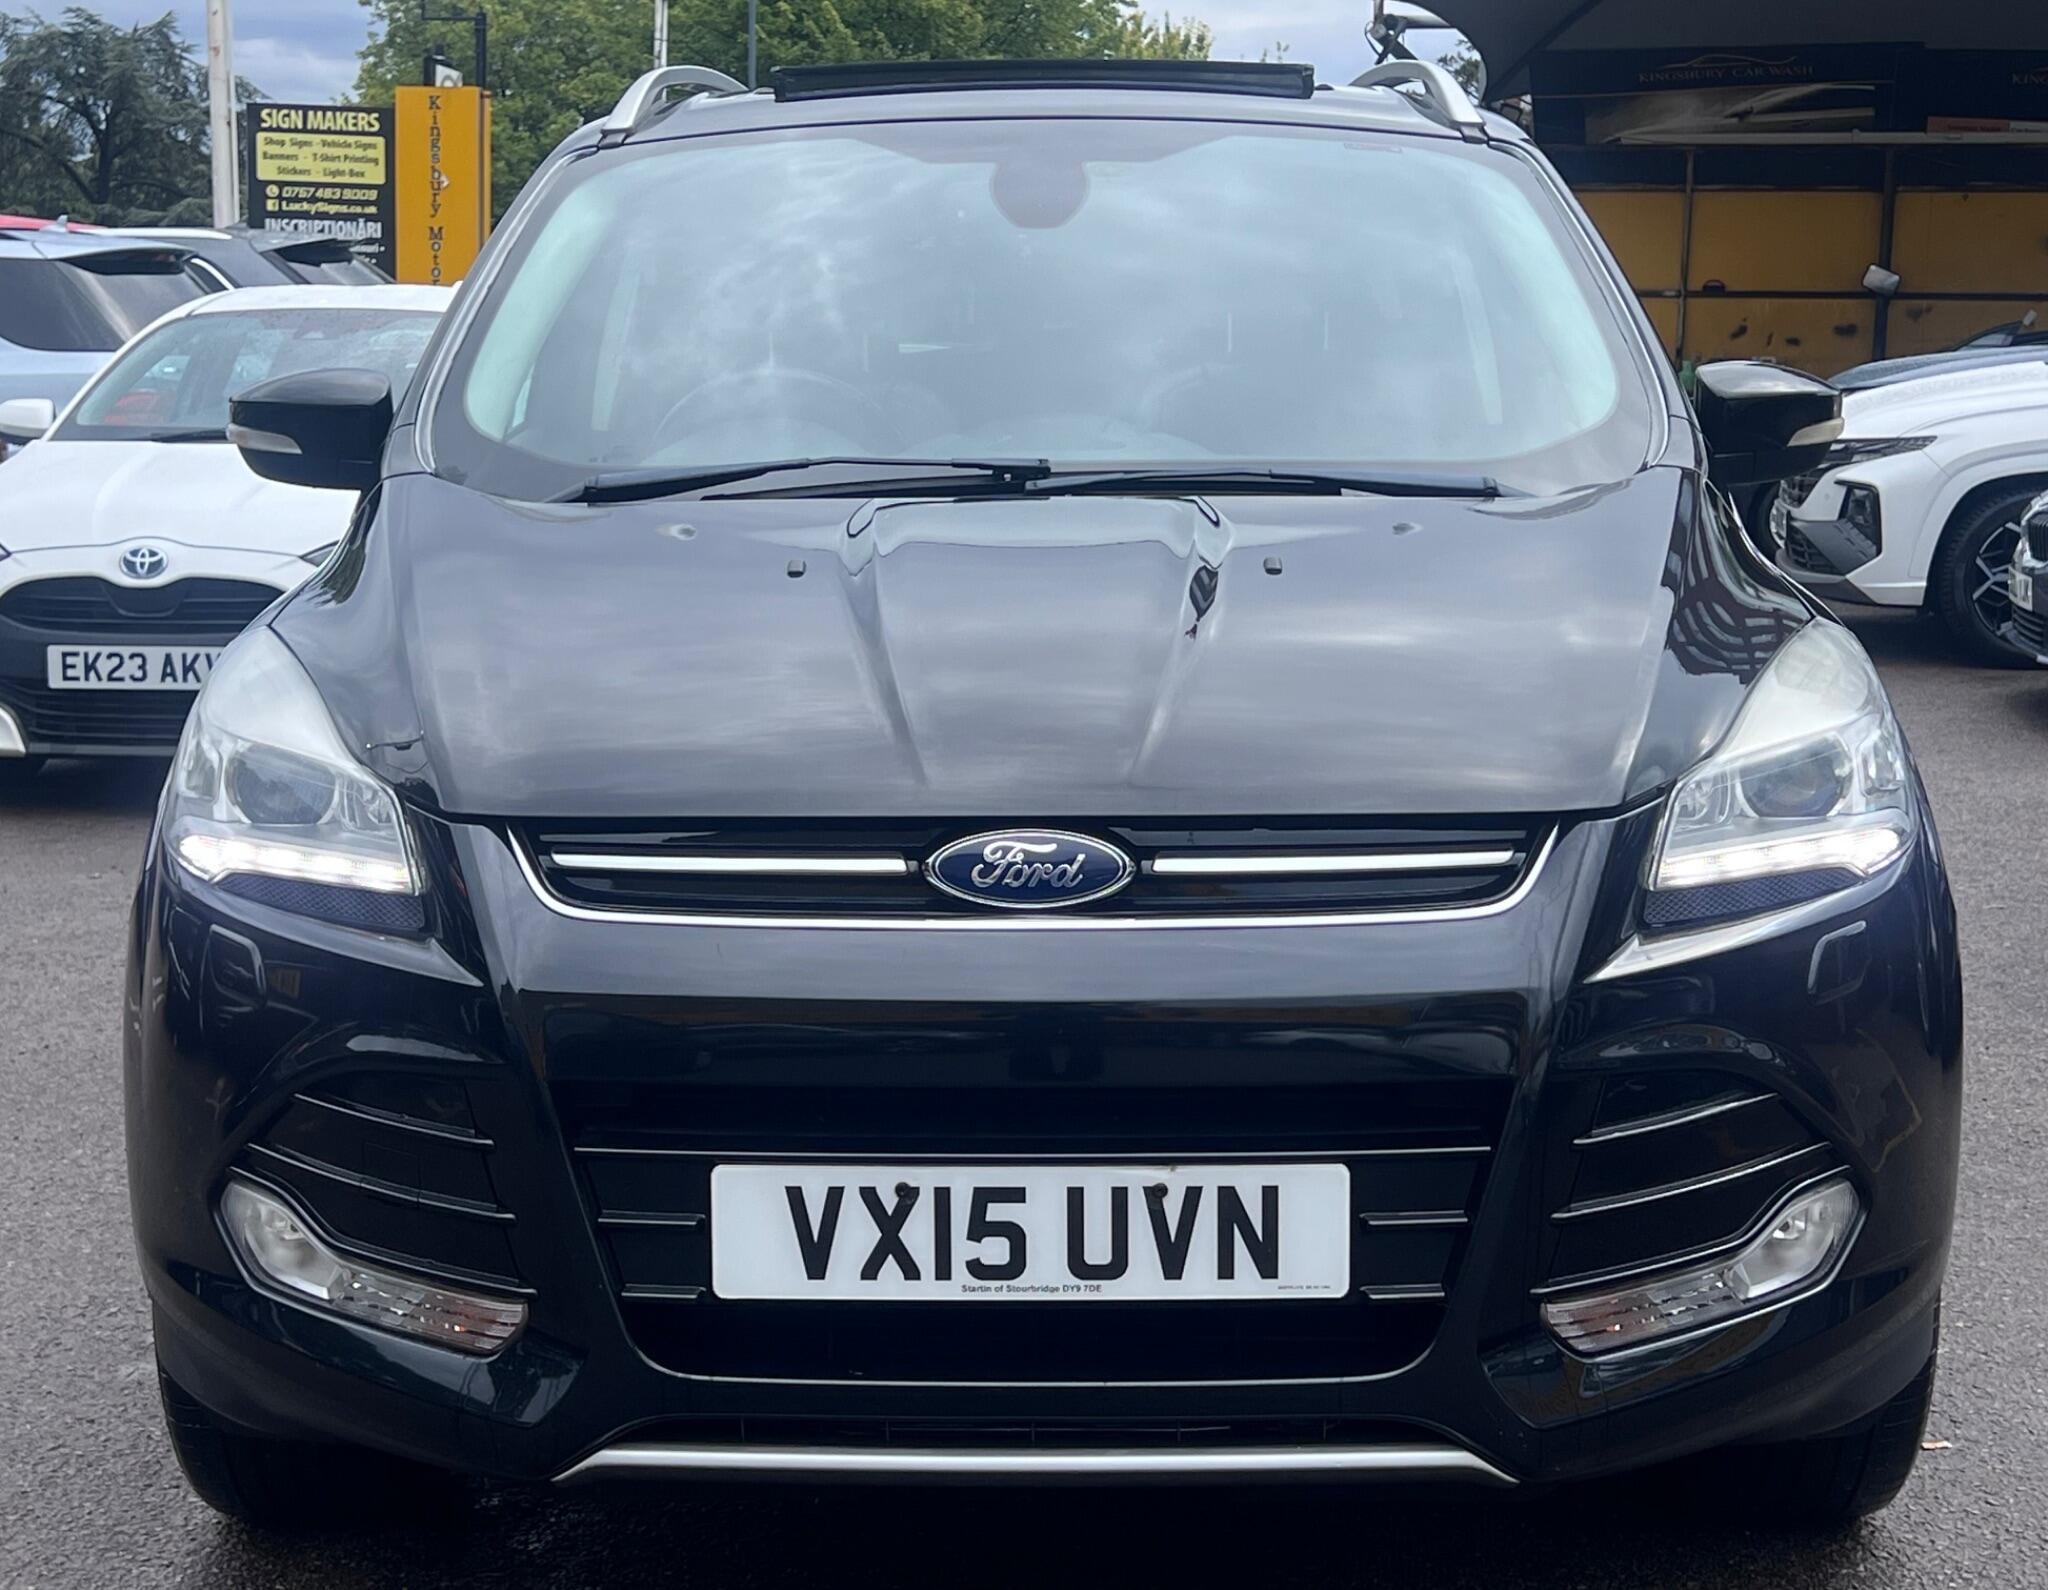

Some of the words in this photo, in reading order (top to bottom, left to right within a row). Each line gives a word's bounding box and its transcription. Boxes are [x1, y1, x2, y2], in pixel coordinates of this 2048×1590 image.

[1732, 66, 1767, 78] CAR
[1768, 65, 1814, 76] WASH
[260, 107, 303, 130] SIGN
[306, 109, 380, 132] MAKERS
[263, 137, 286, 148] Shop
[290, 138, 313, 149] Signs
[320, 139, 352, 149] Vehicle
[354, 140, 378, 151] Signs
[262, 150, 299, 161] Banners
[344, 154, 379, 166] Printing
[428, 95, 442, 218] Kingsbury
[276, 165, 312, 176] Stickers
[61, 651, 149, 683] EK23
[971, 840, 1087, 888] Ford
[785, 1185, 1027, 1281] VX15
[1065, 1185, 1280, 1281] UVN
[961, 1284, 992, 1293] Startin
[994, 1284, 1004, 1293] of
[1006, 1284, 1061, 1294] Stourbridge
[1062, 1284, 1082, 1293] DY9
[1083, 1284, 1102, 1293] 7DE
